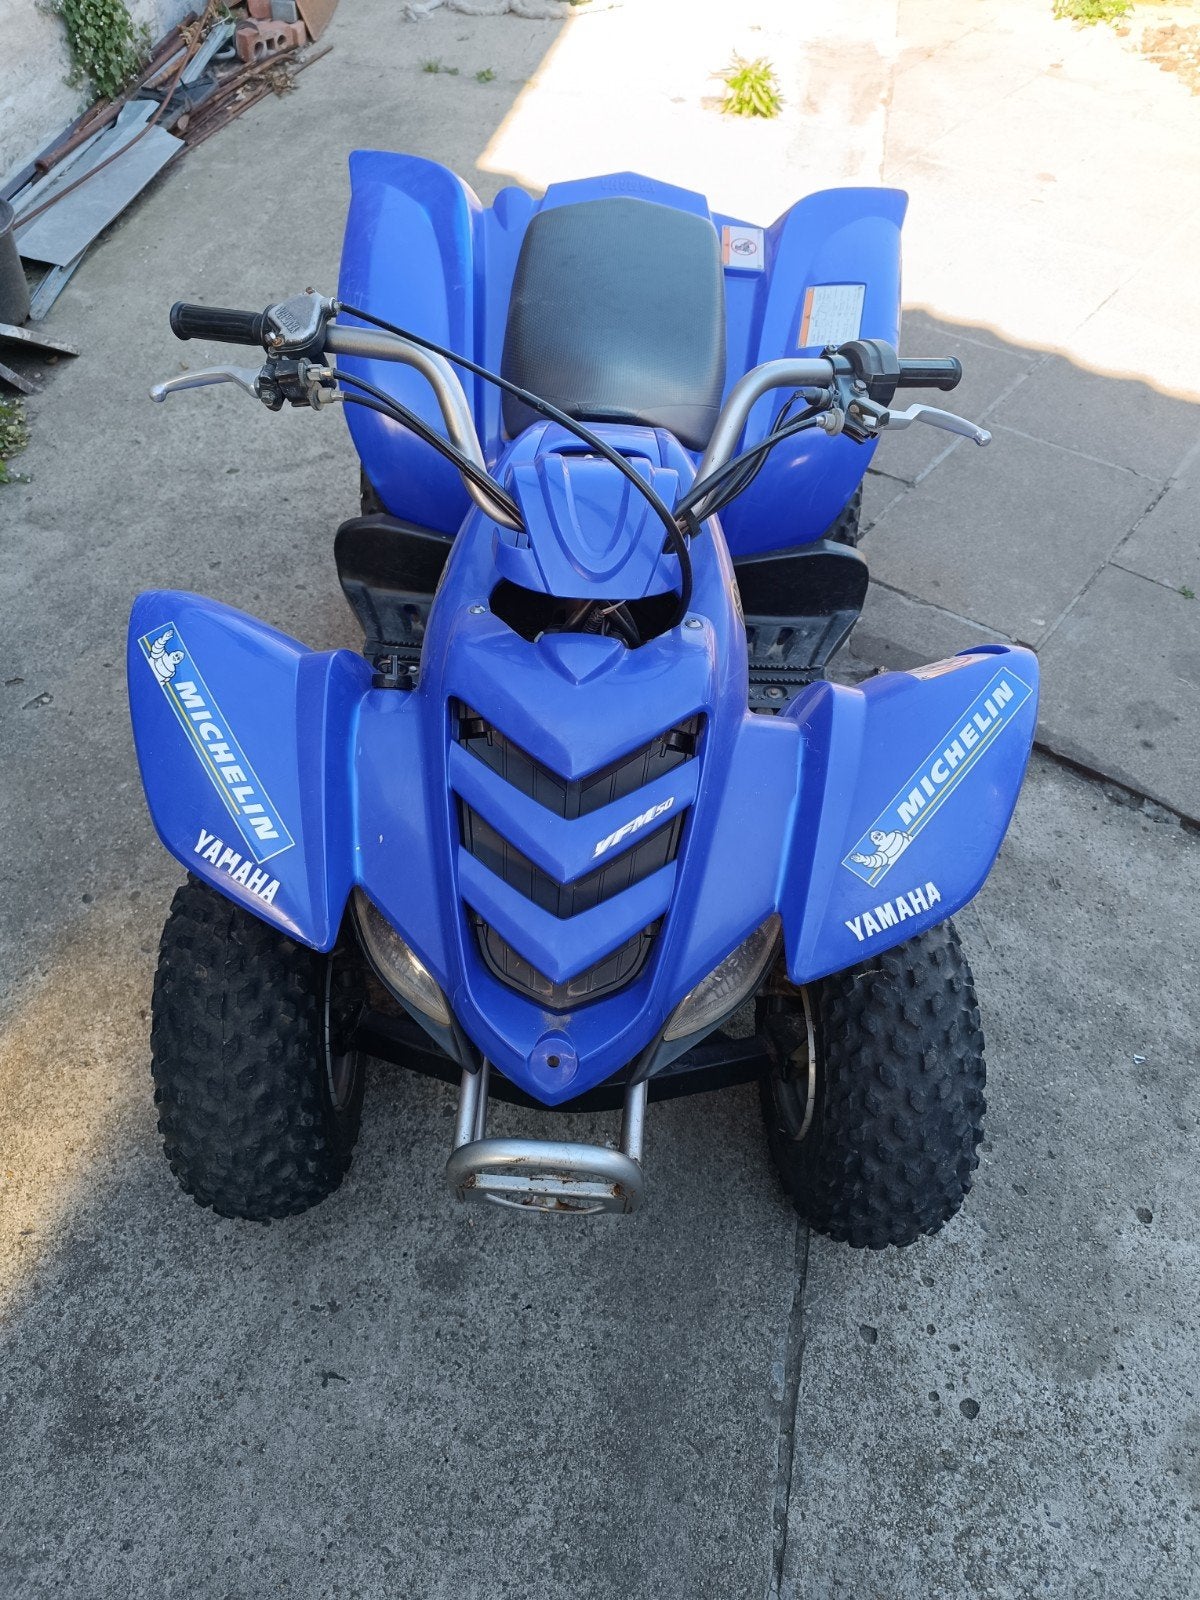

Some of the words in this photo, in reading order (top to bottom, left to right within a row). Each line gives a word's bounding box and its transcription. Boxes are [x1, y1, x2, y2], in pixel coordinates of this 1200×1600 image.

[175, 680, 279, 841] MICHELIN
[896, 680, 1014, 826] MICHELIN
[193, 829, 281, 905] YAMAHA
[844, 881, 941, 942] YAMAHA
